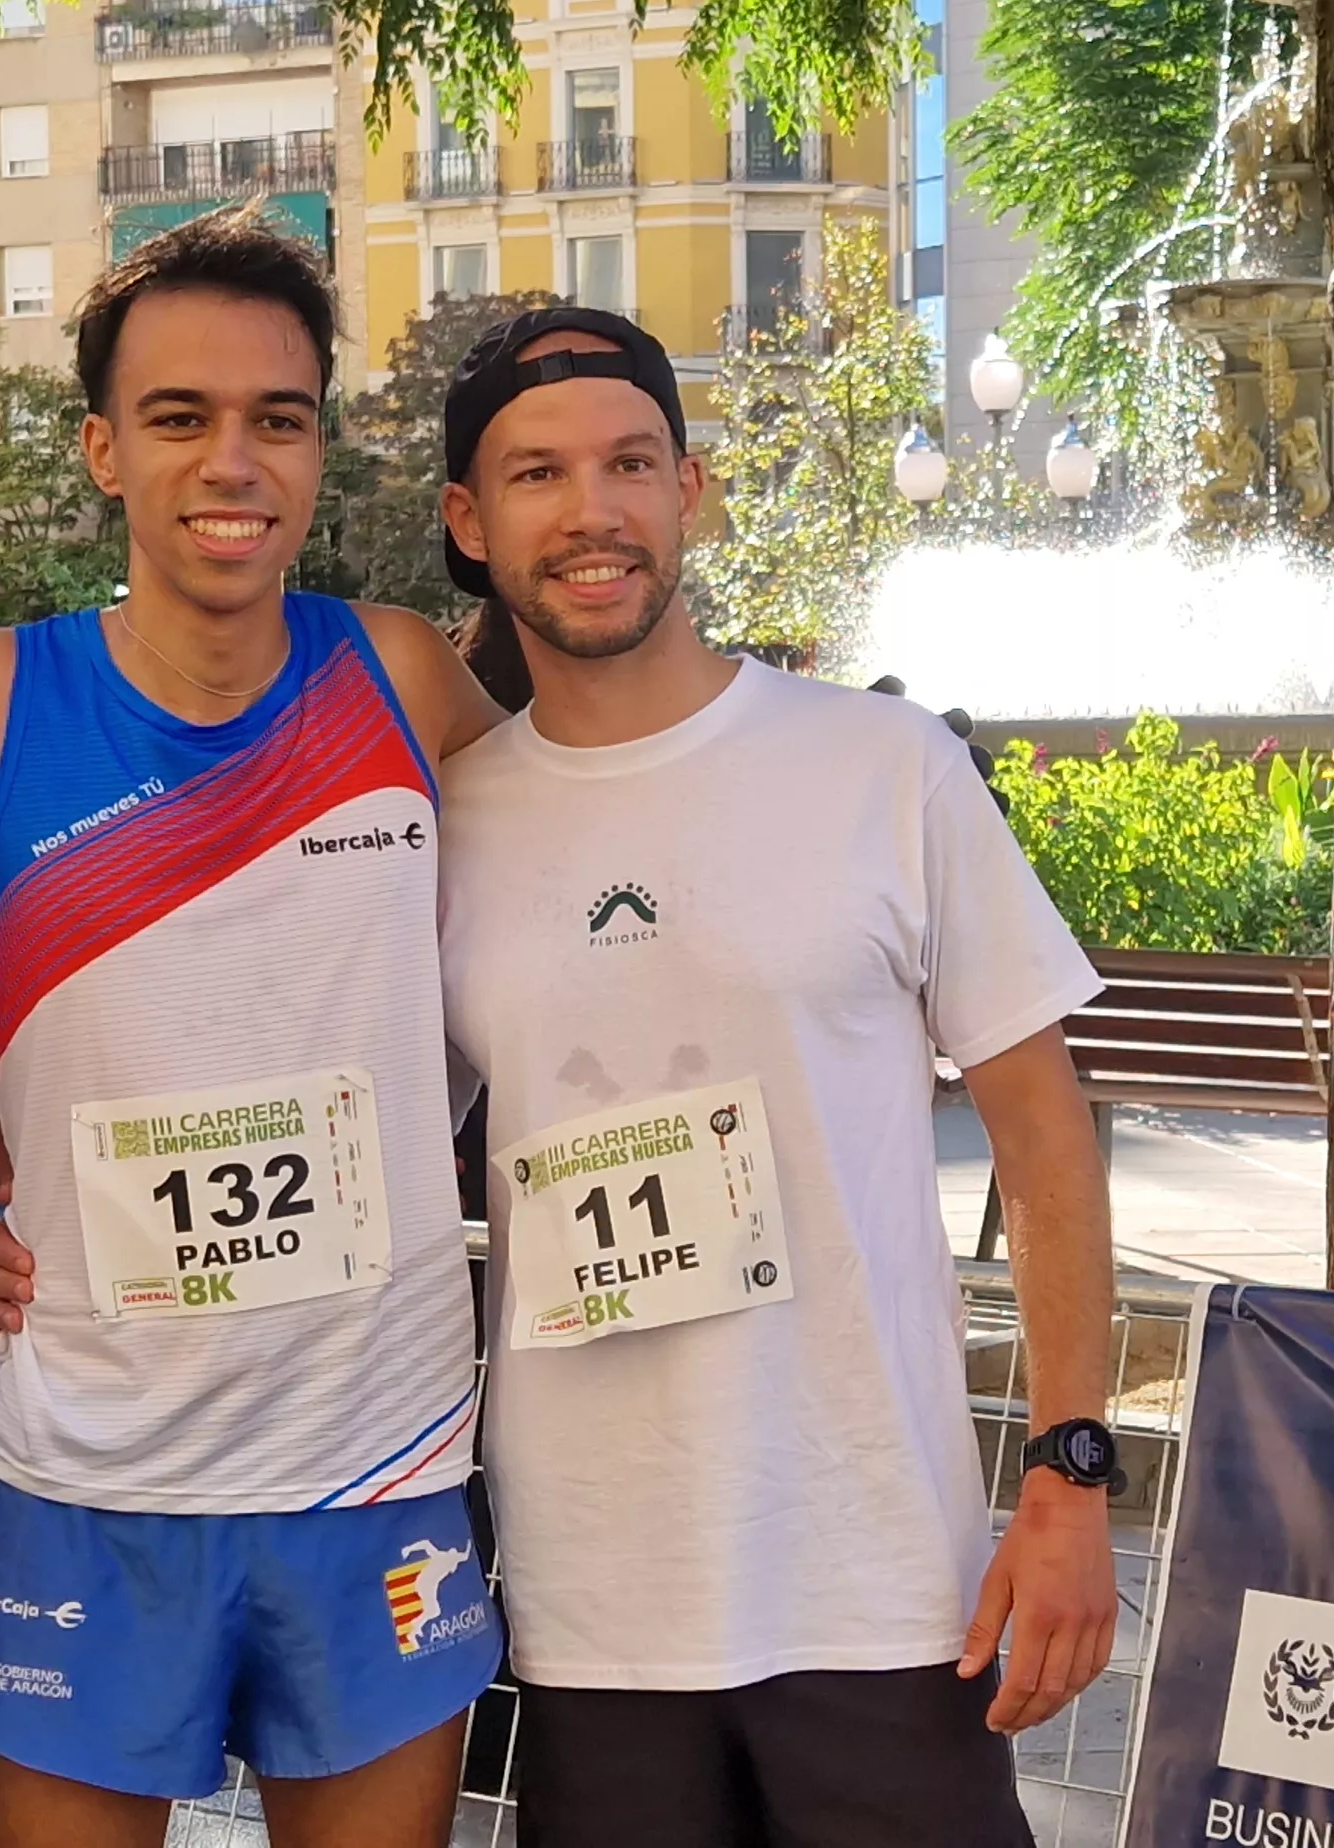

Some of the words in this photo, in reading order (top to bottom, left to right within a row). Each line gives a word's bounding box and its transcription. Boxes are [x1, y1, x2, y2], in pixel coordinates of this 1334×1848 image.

[31, 830, 68, 858] Nos
[69, 792, 140, 836] mueves
[300, 827, 394, 856] Ibercaja
[151, 1116, 173, 1137] III
[179, 1098, 304, 1134] CARRERA
[153, 1127, 242, 1156] EMPRESAS
[246, 1117, 306, 1143] HUESCA
[547, 1143, 565, 1165] III
[571, 1114, 691, 1157] CARRERA
[551, 1146, 629, 1184] EMPRESAS
[632, 1133, 694, 1161] HUESCA
[152, 1153, 315, 1234] 132
[574, 1173, 671, 1250] 11
[175, 1230, 301, 1271] PABLO
[573, 1242, 700, 1293] FELIPE
[181, 1271, 238, 1307] 8K
[583, 1288, 635, 1327] 8K
